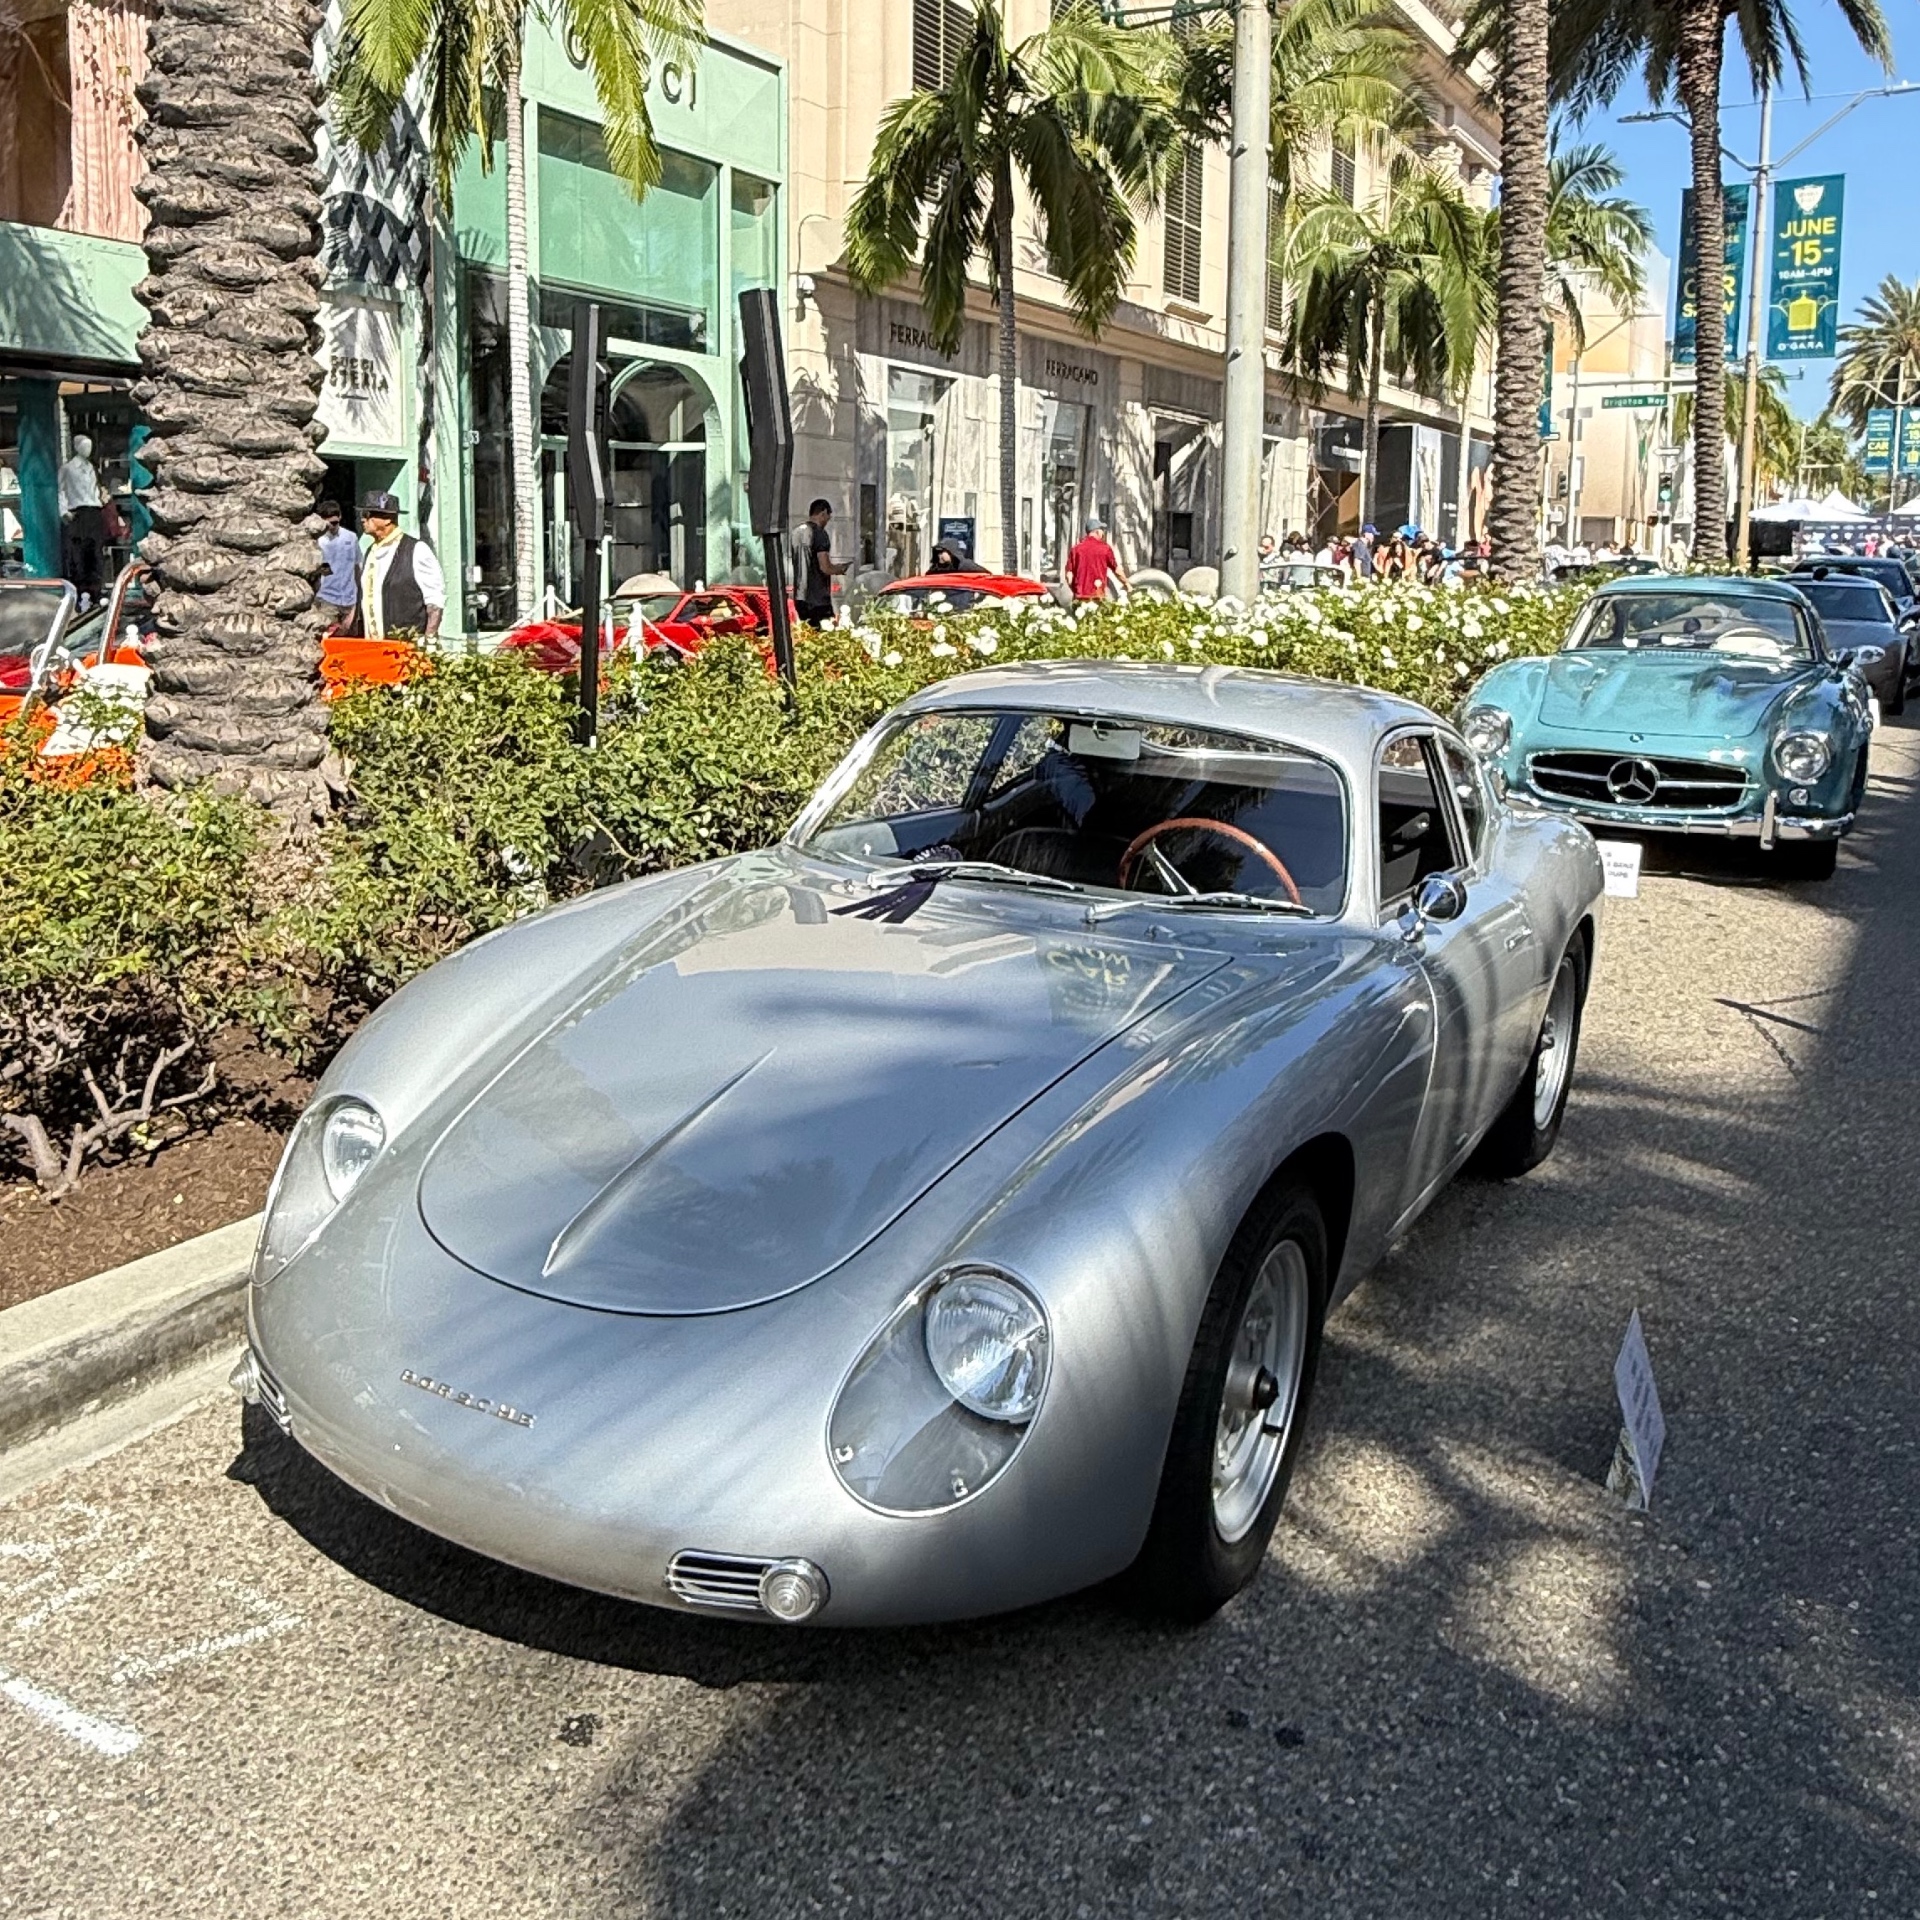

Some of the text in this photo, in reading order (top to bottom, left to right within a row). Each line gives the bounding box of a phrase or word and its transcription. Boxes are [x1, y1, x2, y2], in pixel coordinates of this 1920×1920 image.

[1779, 216, 1837, 239] JUNE
[1683, 276, 1737, 299] CR
[1646, 396, 1666, 406] Way
[400, 1369, 538, 1429] PORSCHE
